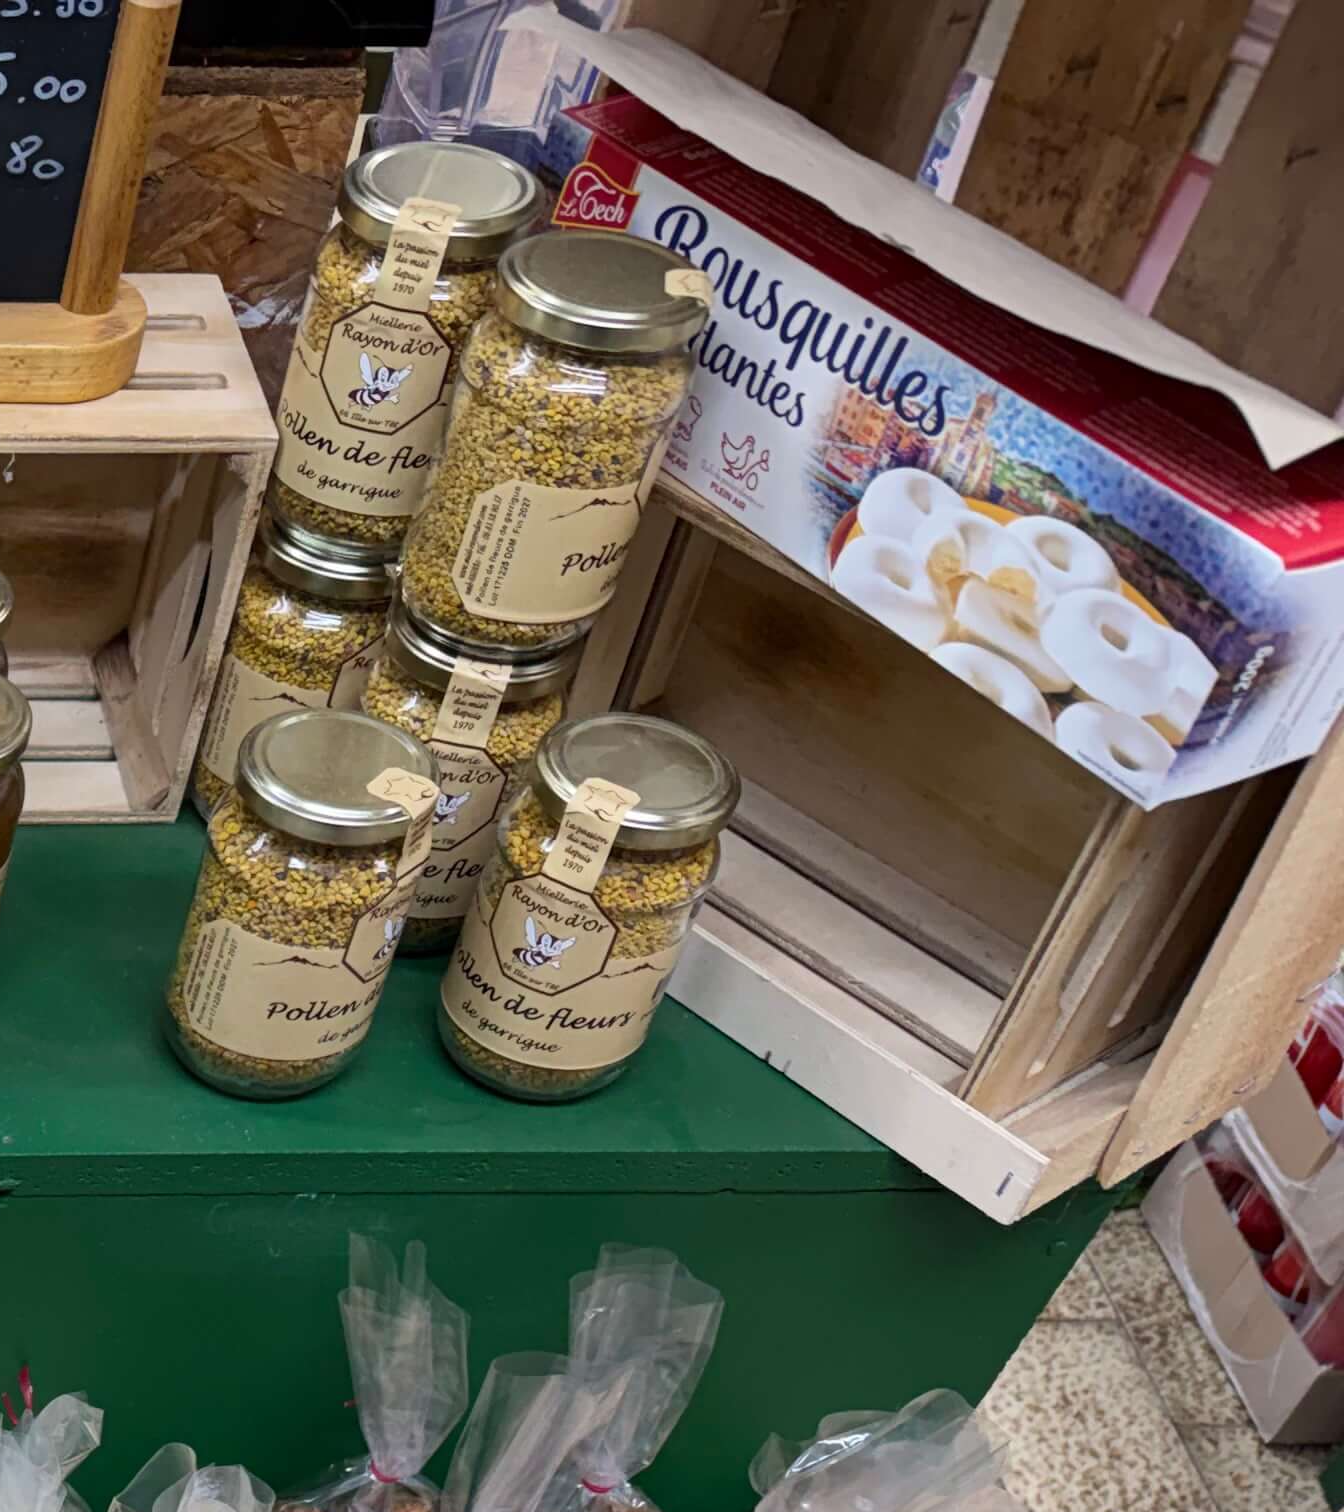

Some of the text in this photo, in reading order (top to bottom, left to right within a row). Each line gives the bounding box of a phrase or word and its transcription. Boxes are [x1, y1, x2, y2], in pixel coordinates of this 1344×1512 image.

[369, 311, 423, 333] Miellerie
[654, 204, 949, 438] Rousquilles
[342, 439, 386, 468] de
[317, 475, 404, 503] garrigue
[266, 995, 363, 1024] Pollen
[547, 1003, 637, 1032] fleurs
[478, 1014, 563, 1055] garrigue
